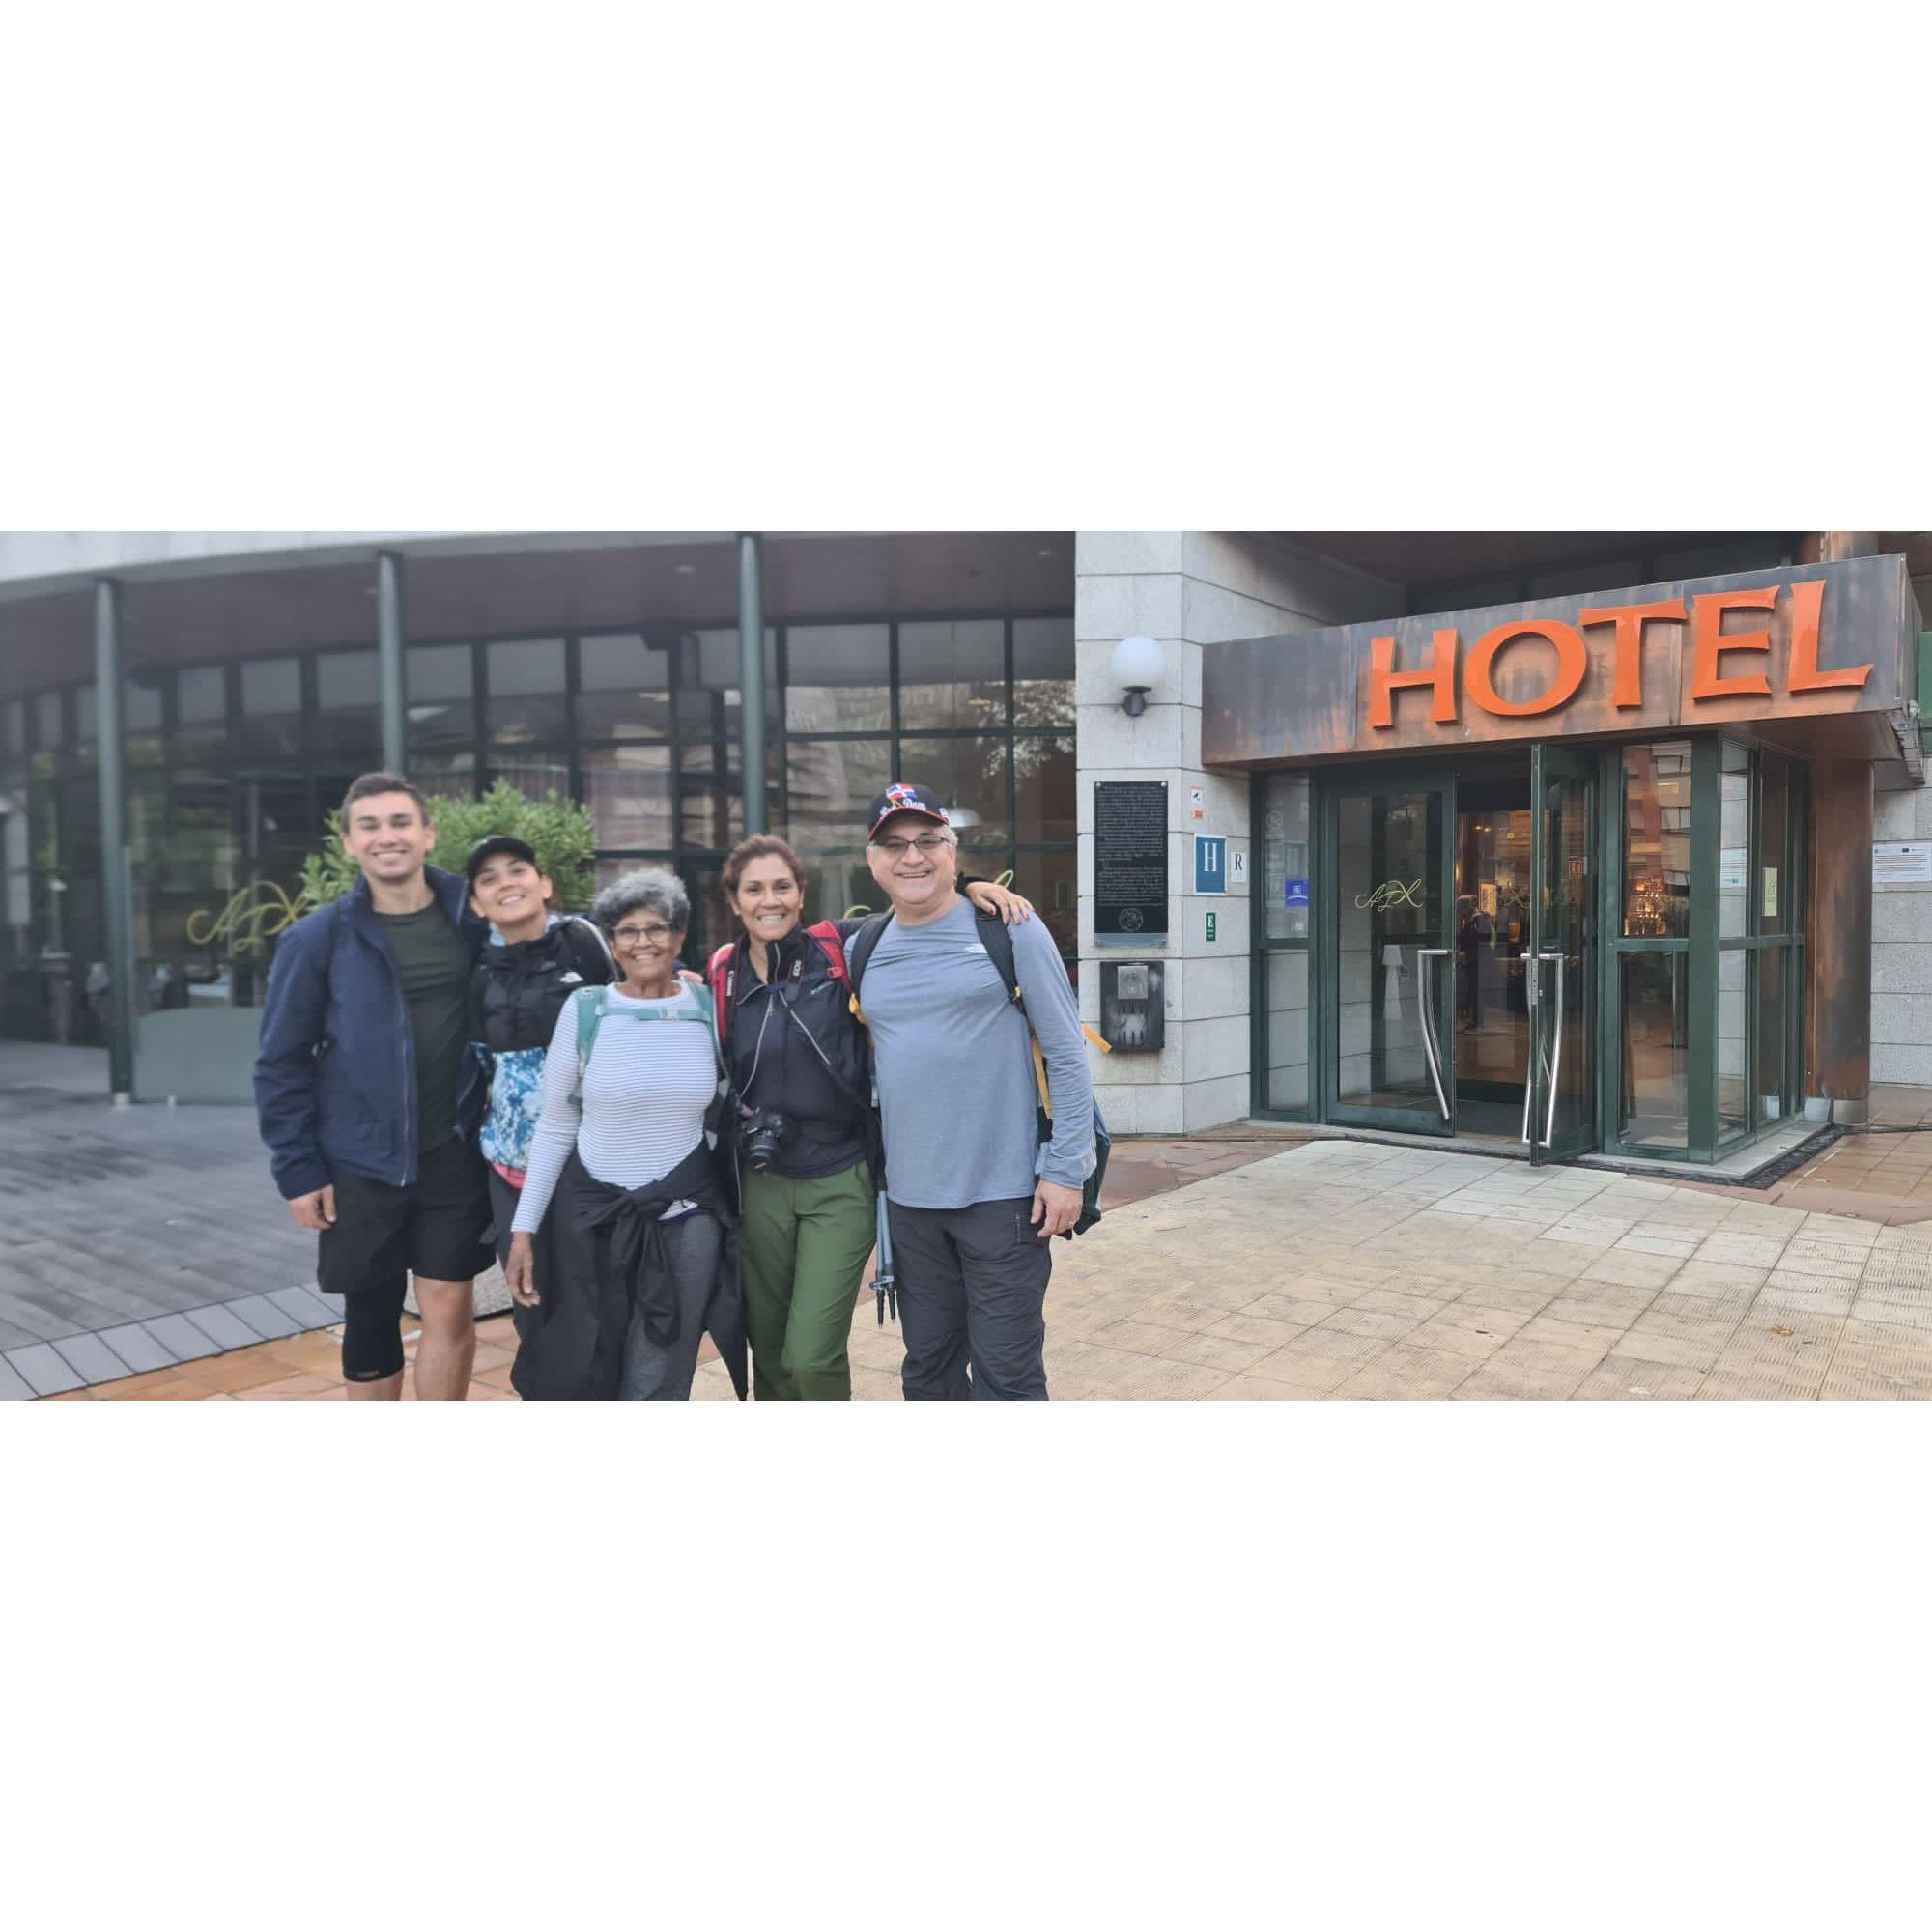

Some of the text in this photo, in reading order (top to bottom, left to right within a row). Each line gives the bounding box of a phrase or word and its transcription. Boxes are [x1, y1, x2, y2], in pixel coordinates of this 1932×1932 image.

[1368, 580, 1875, 728] HOTEL
[1204, 841, 1217, 871] H
[1235, 853, 1242, 870] R
